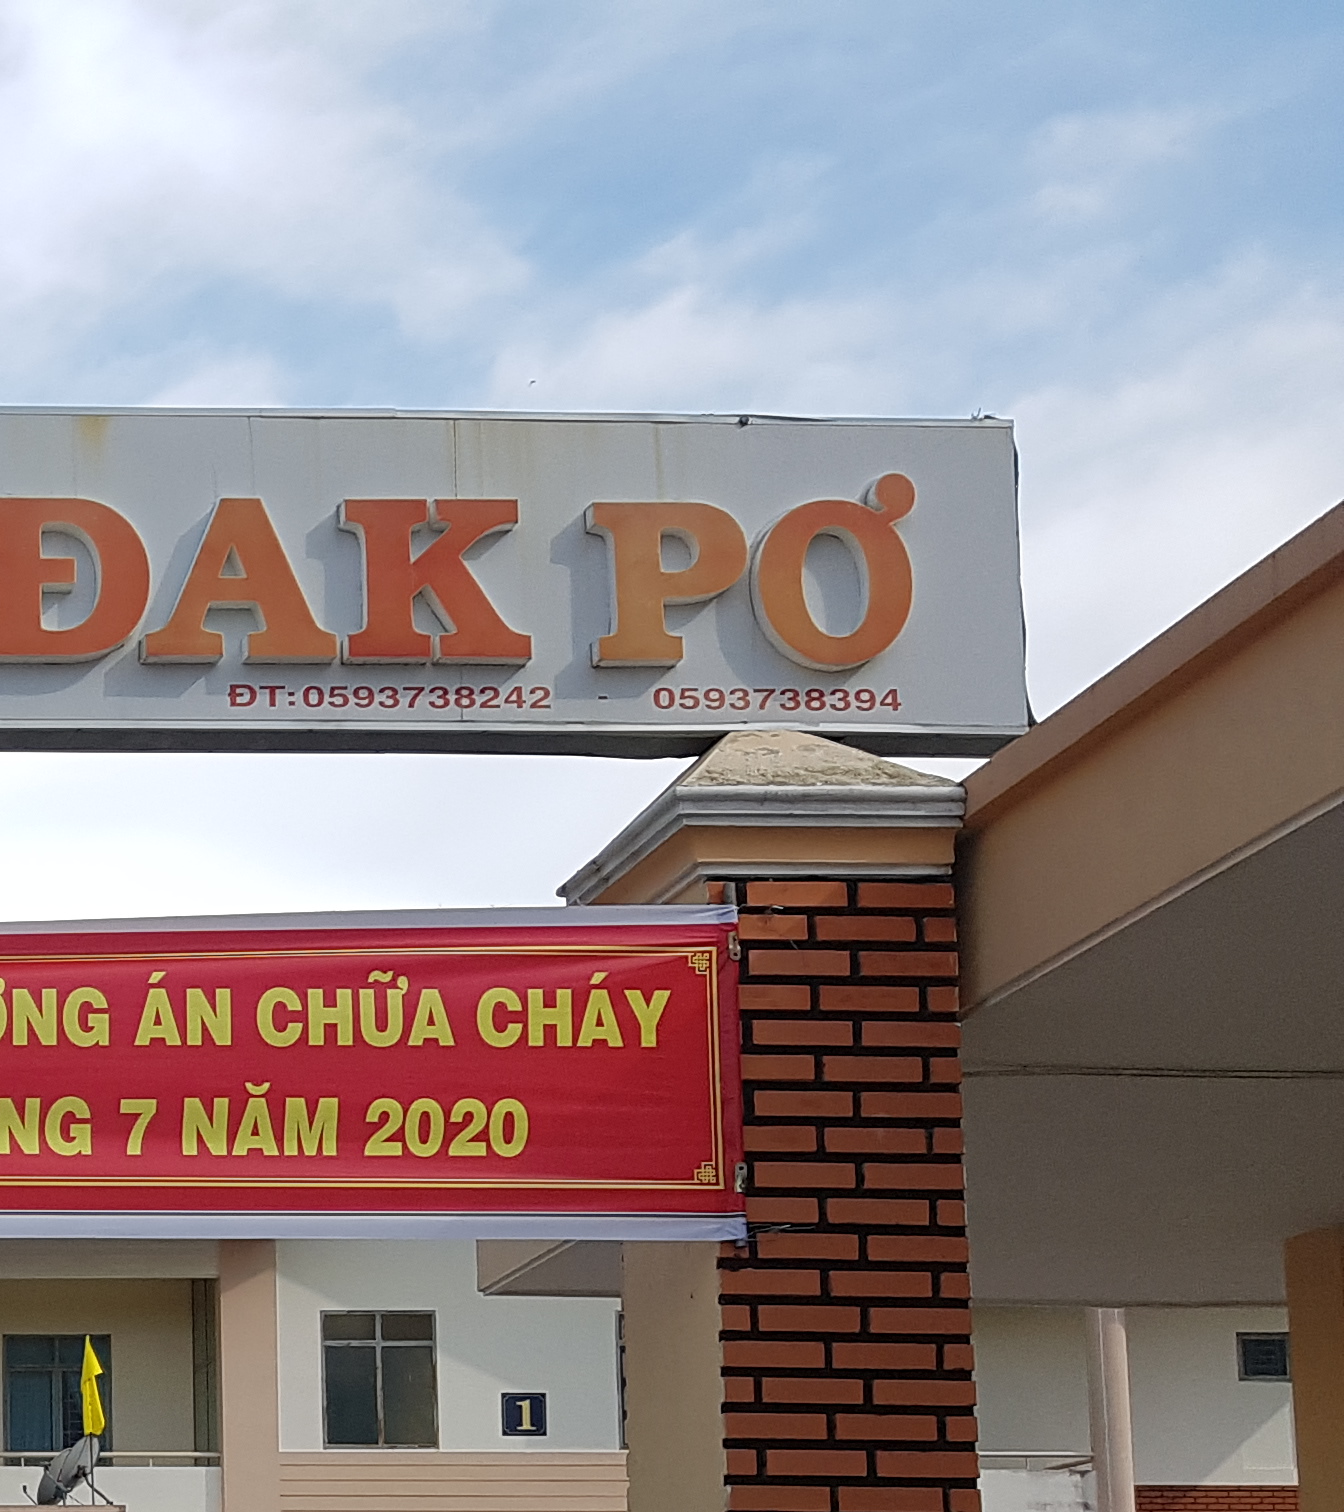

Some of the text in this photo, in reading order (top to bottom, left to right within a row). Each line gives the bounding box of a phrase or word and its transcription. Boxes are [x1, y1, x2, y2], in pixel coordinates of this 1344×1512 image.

[585, 472, 917, 673] PƠ
[228, 684, 903, 713] ĐT:0593738242 0593738394
[133, 971, 233, 1047] ÁN
[255, 970, 456, 1048] CHỮA
[475, 971, 672, 1048] CHÁY
[118, 1097, 159, 1156] 7
[180, 1081, 339, 1157] NĂM
[363, 1097, 529, 1158] 2020
[515, 1398, 537, 1431] 1
